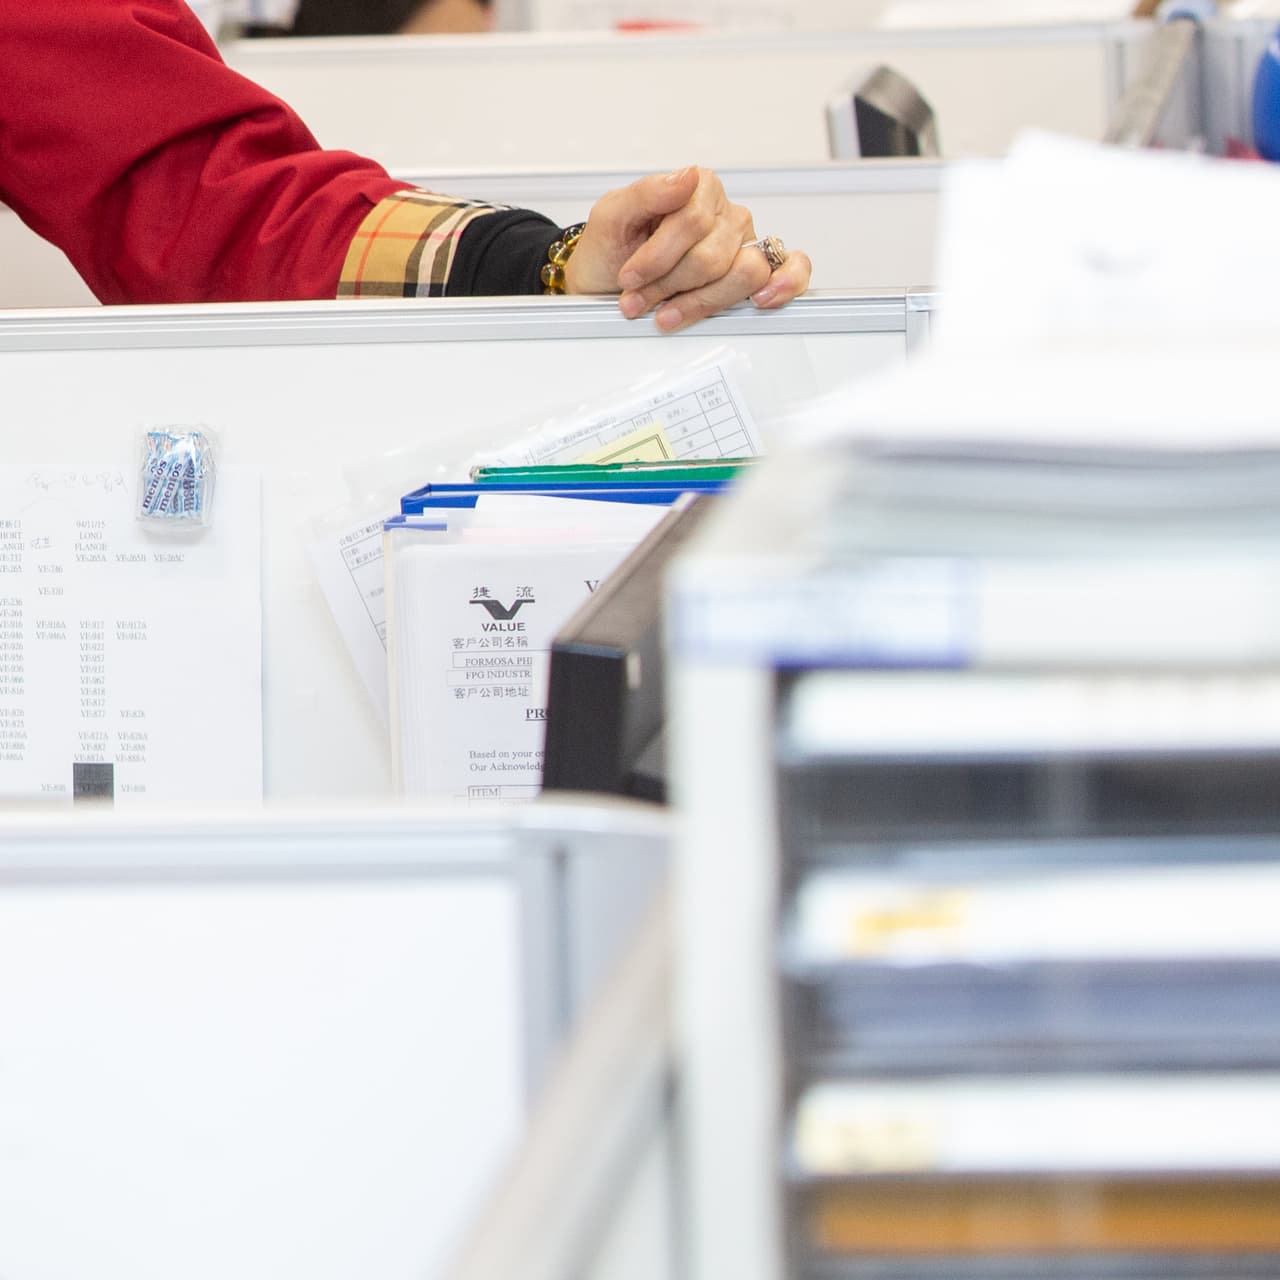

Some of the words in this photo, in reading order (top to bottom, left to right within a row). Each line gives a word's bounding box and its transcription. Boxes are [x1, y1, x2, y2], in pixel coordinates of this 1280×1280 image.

[481, 622, 526, 632] VALUE
[465, 657, 513, 666] FORMOSA
[469, 750, 496, 759] Based
[512, 751, 532, 762] your
[470, 764, 487, 772] Our
[471, 788, 498, 796] ITEM
